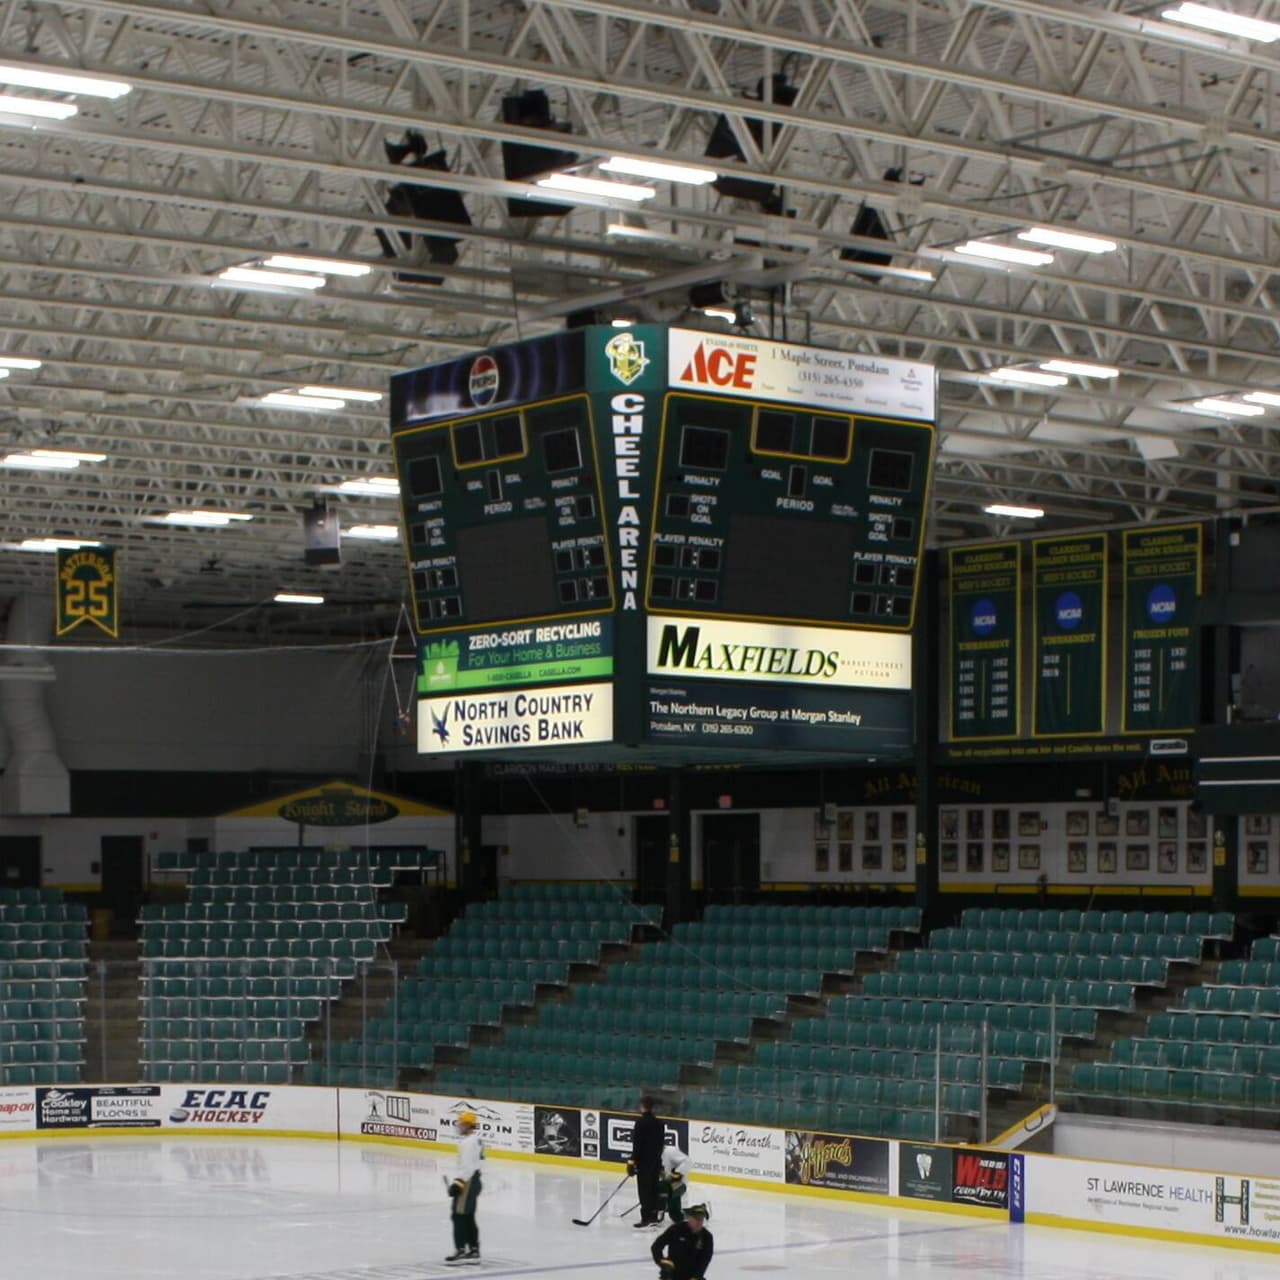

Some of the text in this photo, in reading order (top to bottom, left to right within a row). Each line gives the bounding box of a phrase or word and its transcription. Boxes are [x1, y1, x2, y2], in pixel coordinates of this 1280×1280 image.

[679, 341, 757, 389] ACE
[780, 350, 811, 366] Maple
[814, 355, 846, 370] Street,
[848, 359, 890, 376] Potsdam
[683, 475, 721, 487] PENALTY
[484, 502, 513, 515] PERIOD
[610, 393, 646, 611] CHEEL ARENA
[776, 497, 815, 512] PERIOD
[654, 533, 724, 548] PLAYER PENALTY
[853, 551, 917, 565] PLAYER PENALTY
[65, 579, 109, 617] 25
[1150, 600, 1177, 613] NCAA
[468, 621, 602, 651] ZERO-SORT RECYCLING
[468, 641, 602, 668] For Your Home & Business
[657, 624, 839, 678] MAXFIELDS
[455, 693, 594, 722] NORTH COUNTRY
[649, 700, 862, 727] The Northern Legacy Group at Morgan Stanley
[463, 719, 584, 746] SAVINGS BANK
[285, 801, 337, 819] Knight
[41, 1099, 88, 1110] Coakley
[96, 1098, 153, 1108] BEAUTIFUL
[181, 1090, 271, 1109] ECAC
[42, 1108, 69, 1116] Home
[42, 1114, 88, 1123] Hardware
[96, 1109, 139, 1118] FLOORS
[190, 1109, 265, 1123] HOCKEY
[361, 1122, 436, 1140] JCMERRIMAN.COM
[701, 1126, 773, 1150] Eben's Hearth
[956, 1154, 1008, 1191] WILD
[1087, 1177, 1213, 1204] ST LAWRENCE HEALTH
